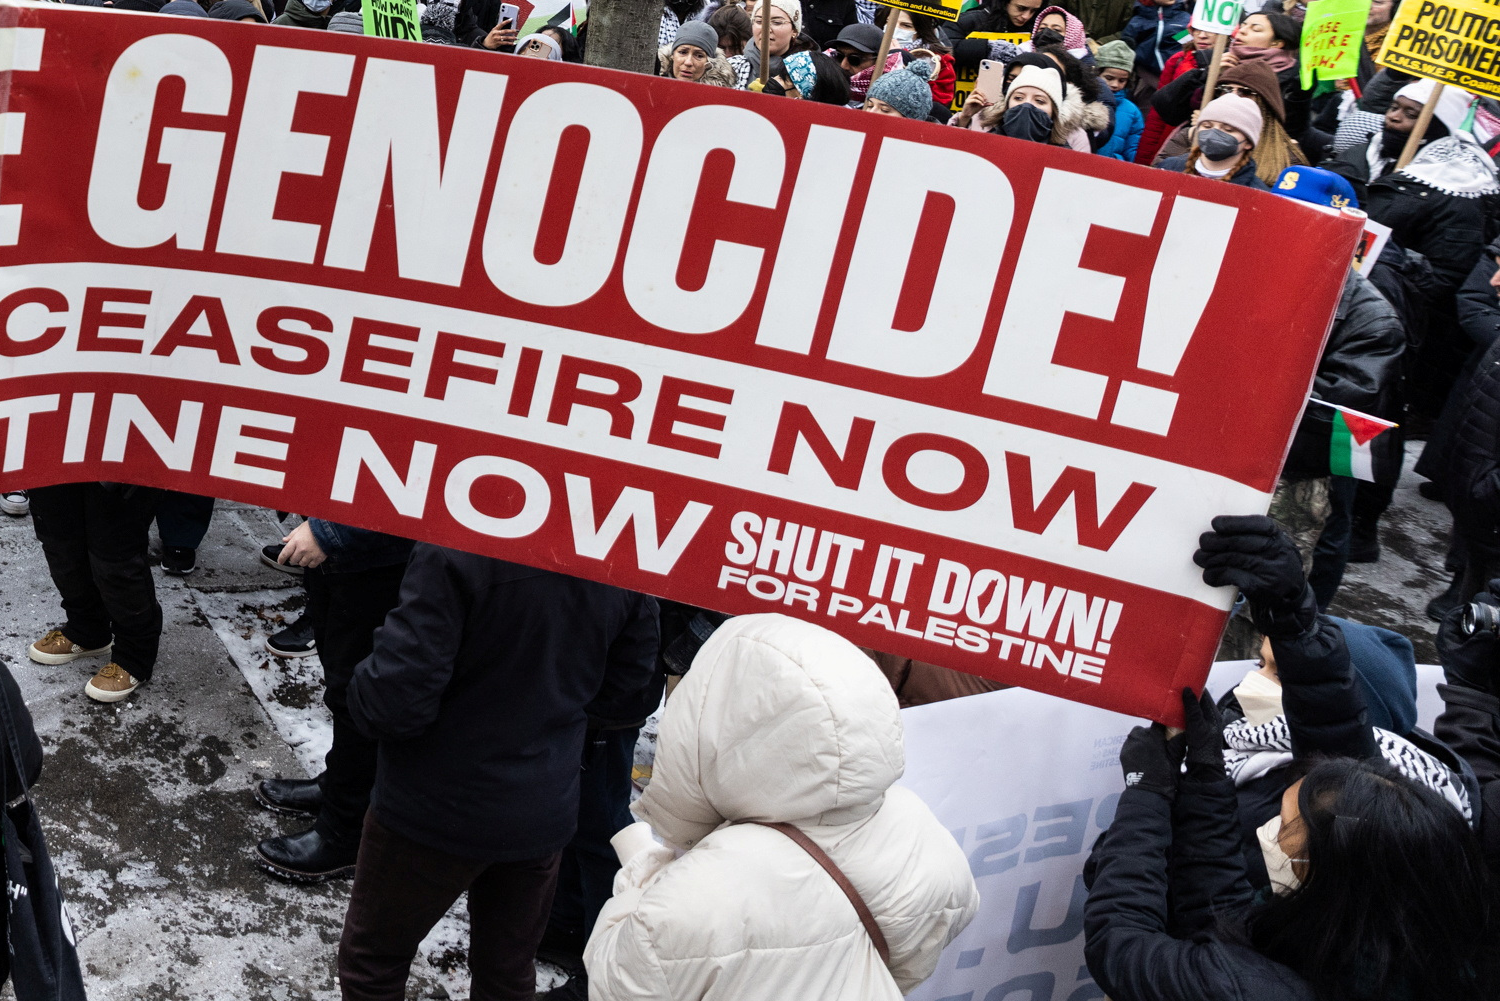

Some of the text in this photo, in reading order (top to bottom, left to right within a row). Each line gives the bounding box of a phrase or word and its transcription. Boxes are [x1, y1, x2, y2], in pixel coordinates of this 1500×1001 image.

[372, 9, 418, 41] KIDS
[389, 2, 413, 20] MANY
[910, 1, 923, 11] and
[923, 4, 957, 19] Liberation
[1416, 0, 1500, 46] POLITIC
[87, 33, 1238, 437] GENOCIDE!
[330, 425, 712, 575] NOW
[766, 401, 1157, 552] NOW
[717, 565, 1106, 684] FOR PALESTINE
[724, 511, 1124, 655] SHUT IT DOWN!
